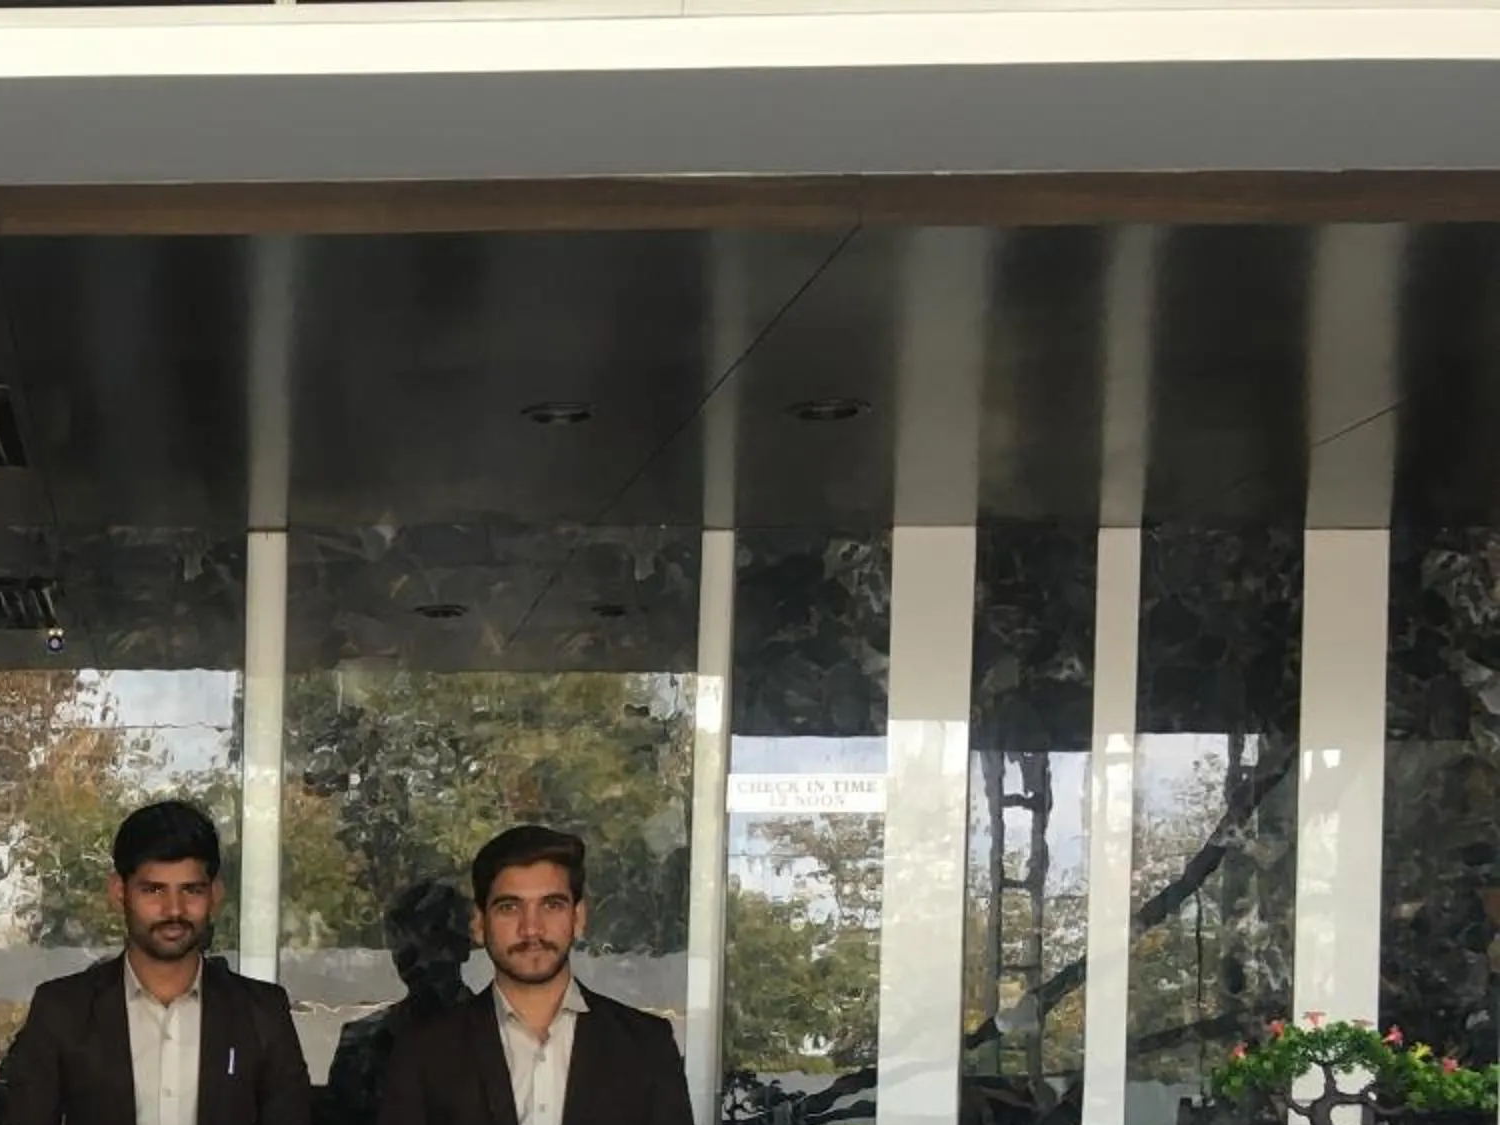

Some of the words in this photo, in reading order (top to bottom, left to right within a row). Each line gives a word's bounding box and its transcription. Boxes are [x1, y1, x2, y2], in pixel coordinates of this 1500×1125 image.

[737, 780, 799, 793] CHECK
[806, 780, 825, 793] IN
[832, 780, 878, 793] TIME
